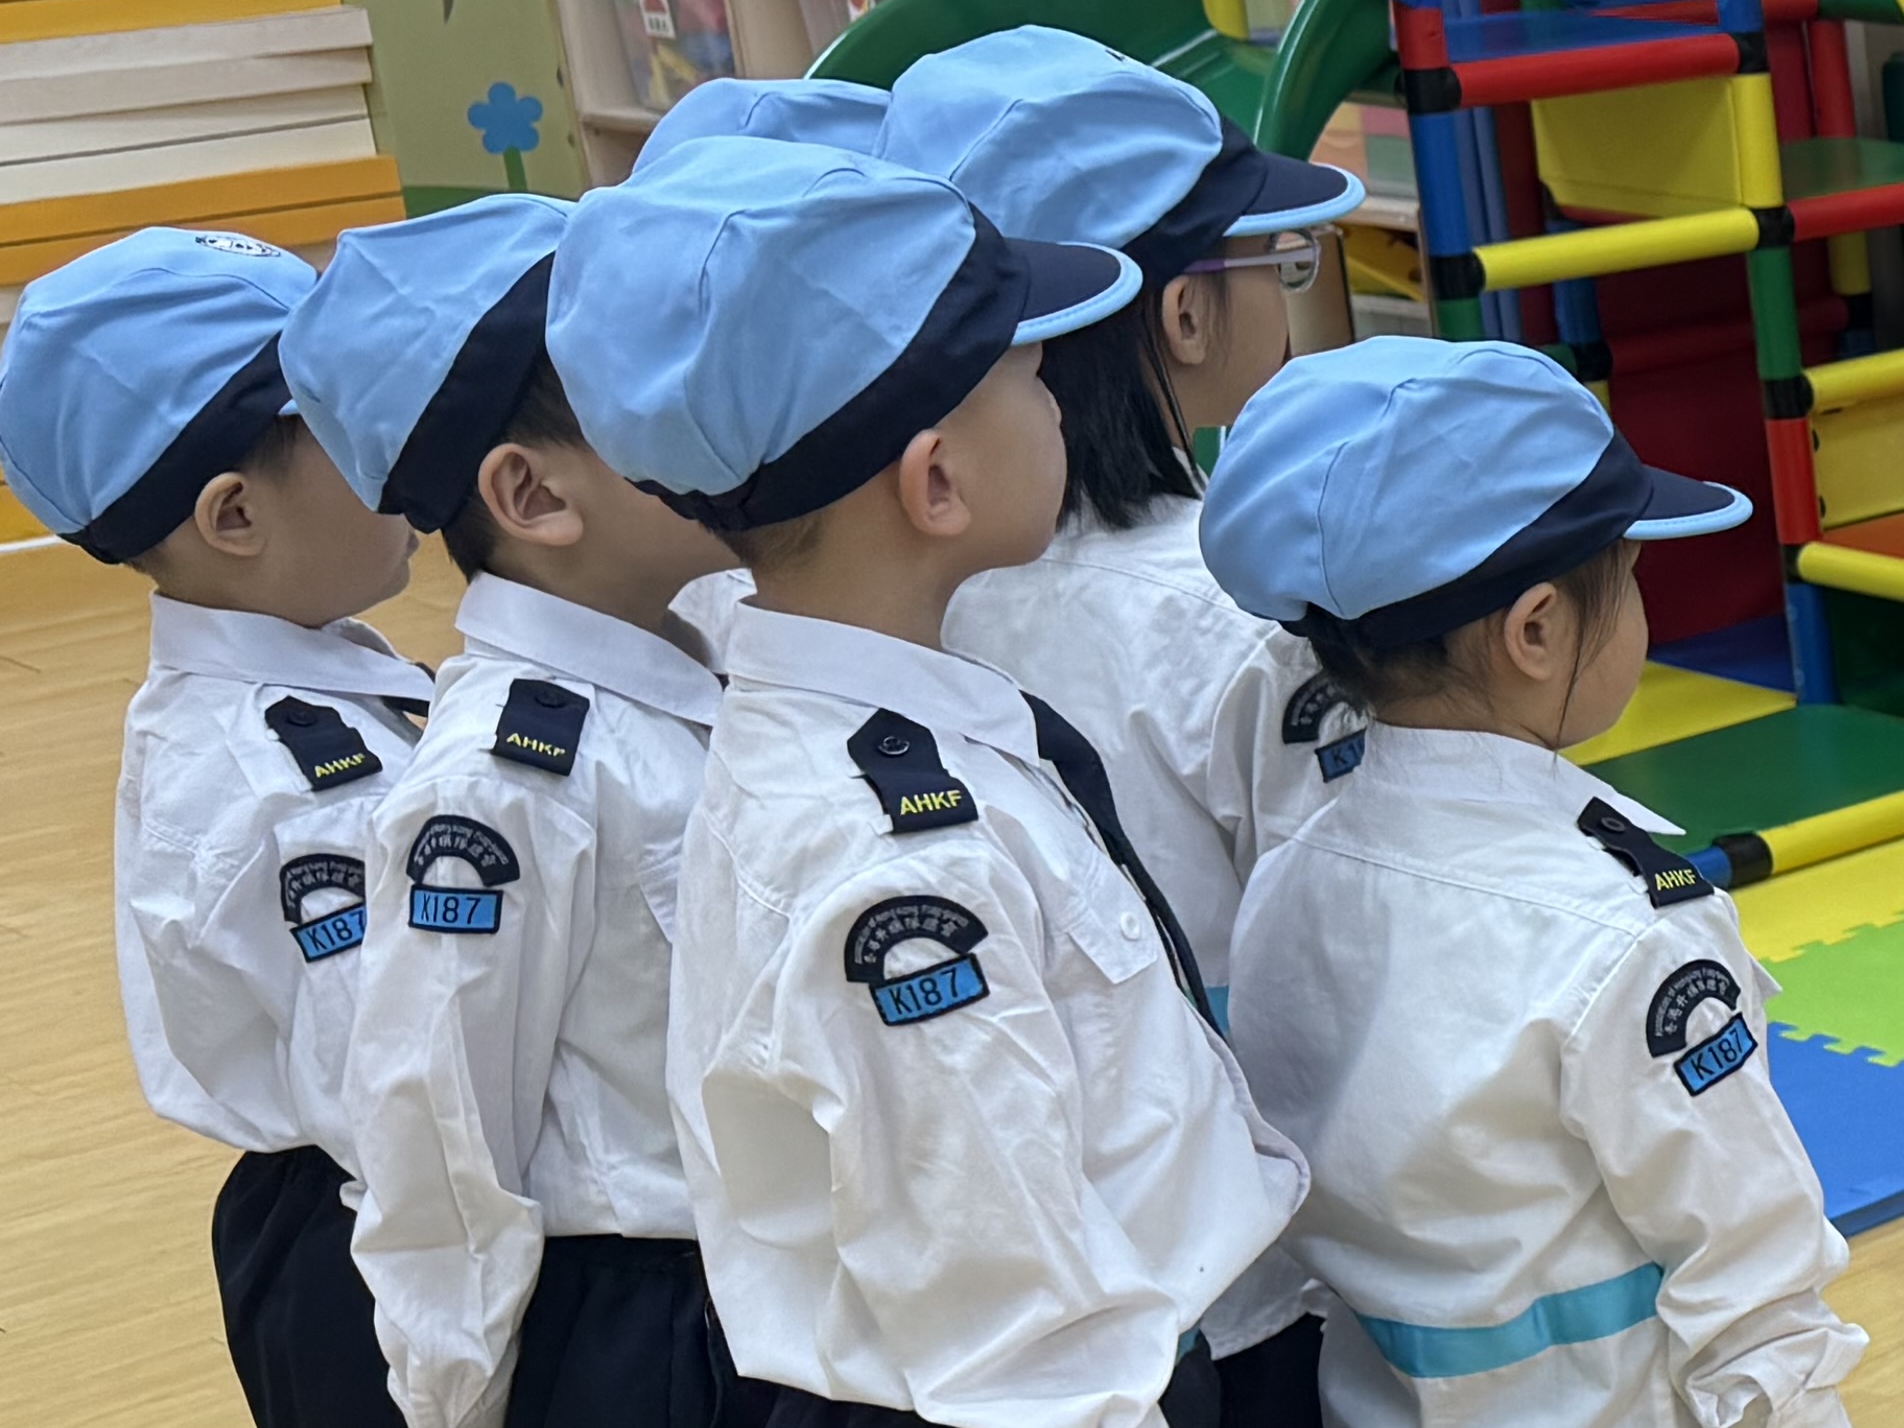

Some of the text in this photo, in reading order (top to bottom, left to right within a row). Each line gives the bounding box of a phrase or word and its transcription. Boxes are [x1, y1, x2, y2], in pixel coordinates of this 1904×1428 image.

[506, 732, 566, 757] AHKF
[314, 753, 366, 778] AHKF
[900, 789, 963, 816] AHKF
[1654, 869, 1696, 892] AHKF
[420, 894, 482, 925] K187
[306, 911, 365, 952] K187
[888, 967, 959, 1015] K187
[1690, 1030, 1745, 1081] K187
